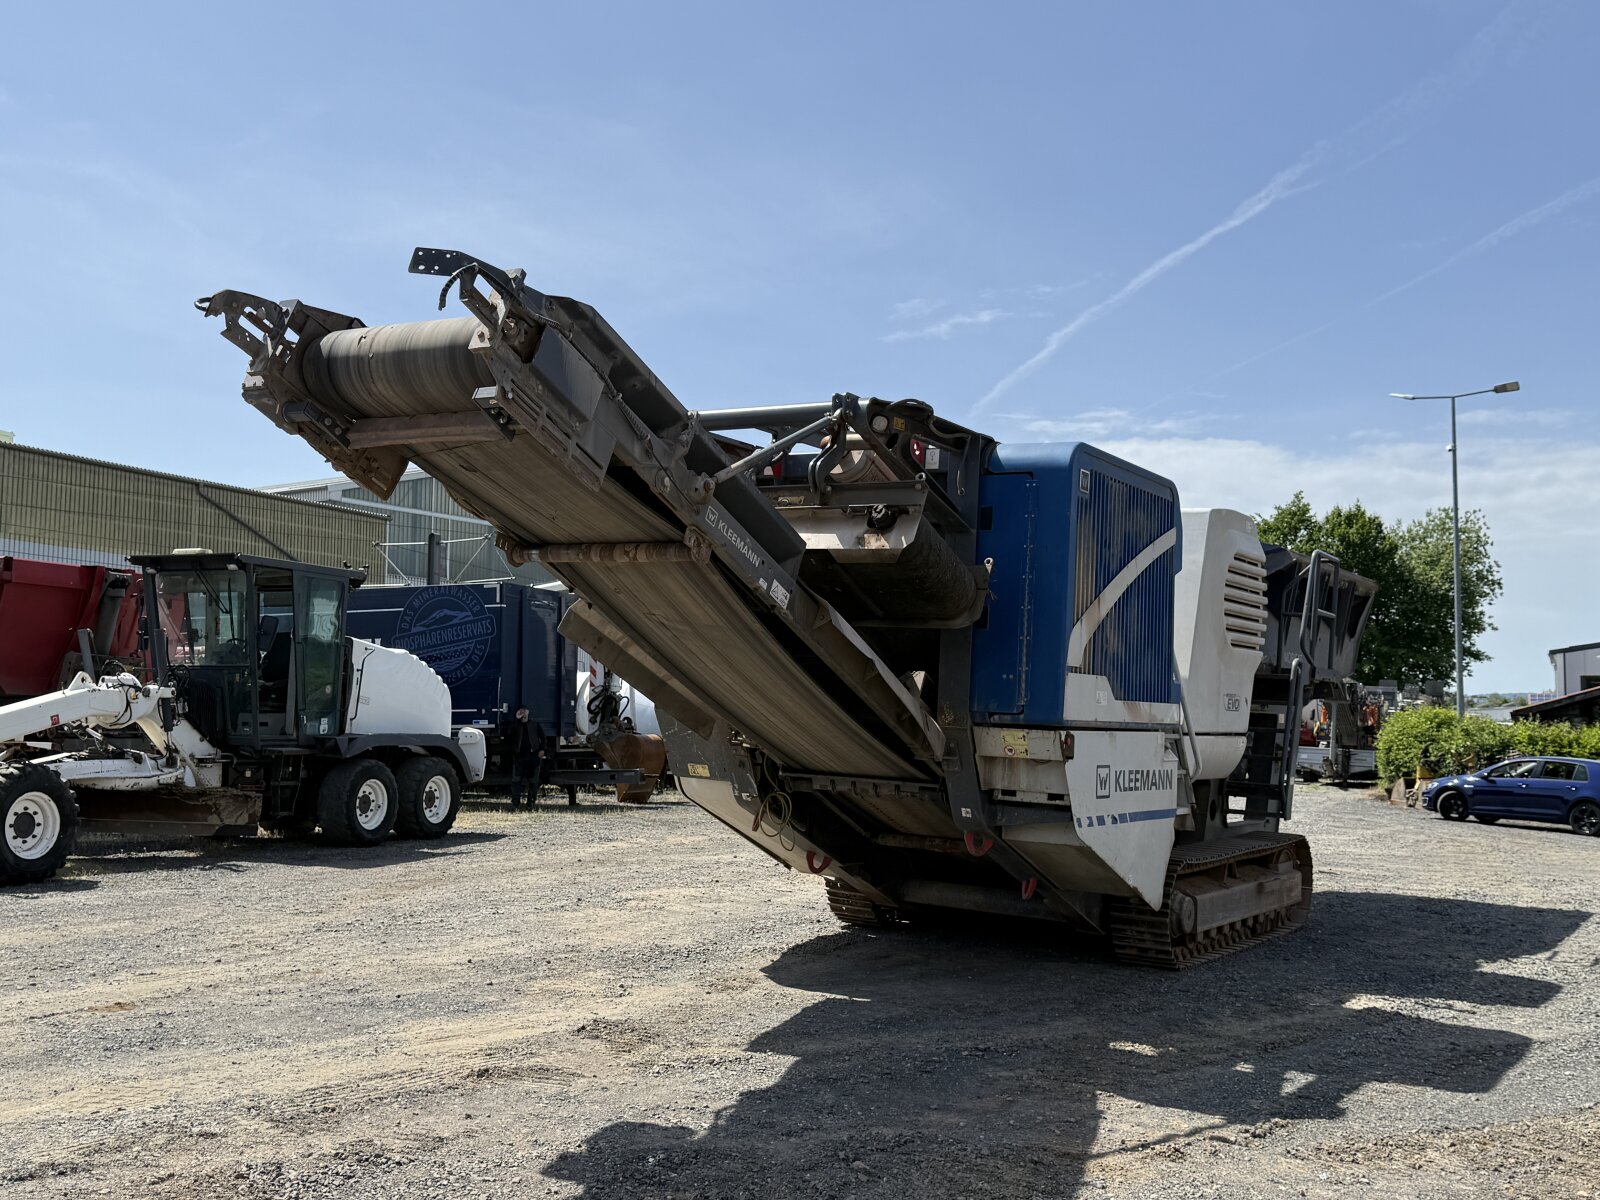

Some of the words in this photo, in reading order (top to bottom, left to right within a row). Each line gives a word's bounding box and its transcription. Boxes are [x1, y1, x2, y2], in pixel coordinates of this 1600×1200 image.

[718, 520, 760, 568] KLEEMANN
[402, 610, 414, 629] DAS
[412, 585, 481, 613] MINERALWASSER
[472, 643, 485, 663] DES
[1114, 769, 1173, 792] KLEEMANN
